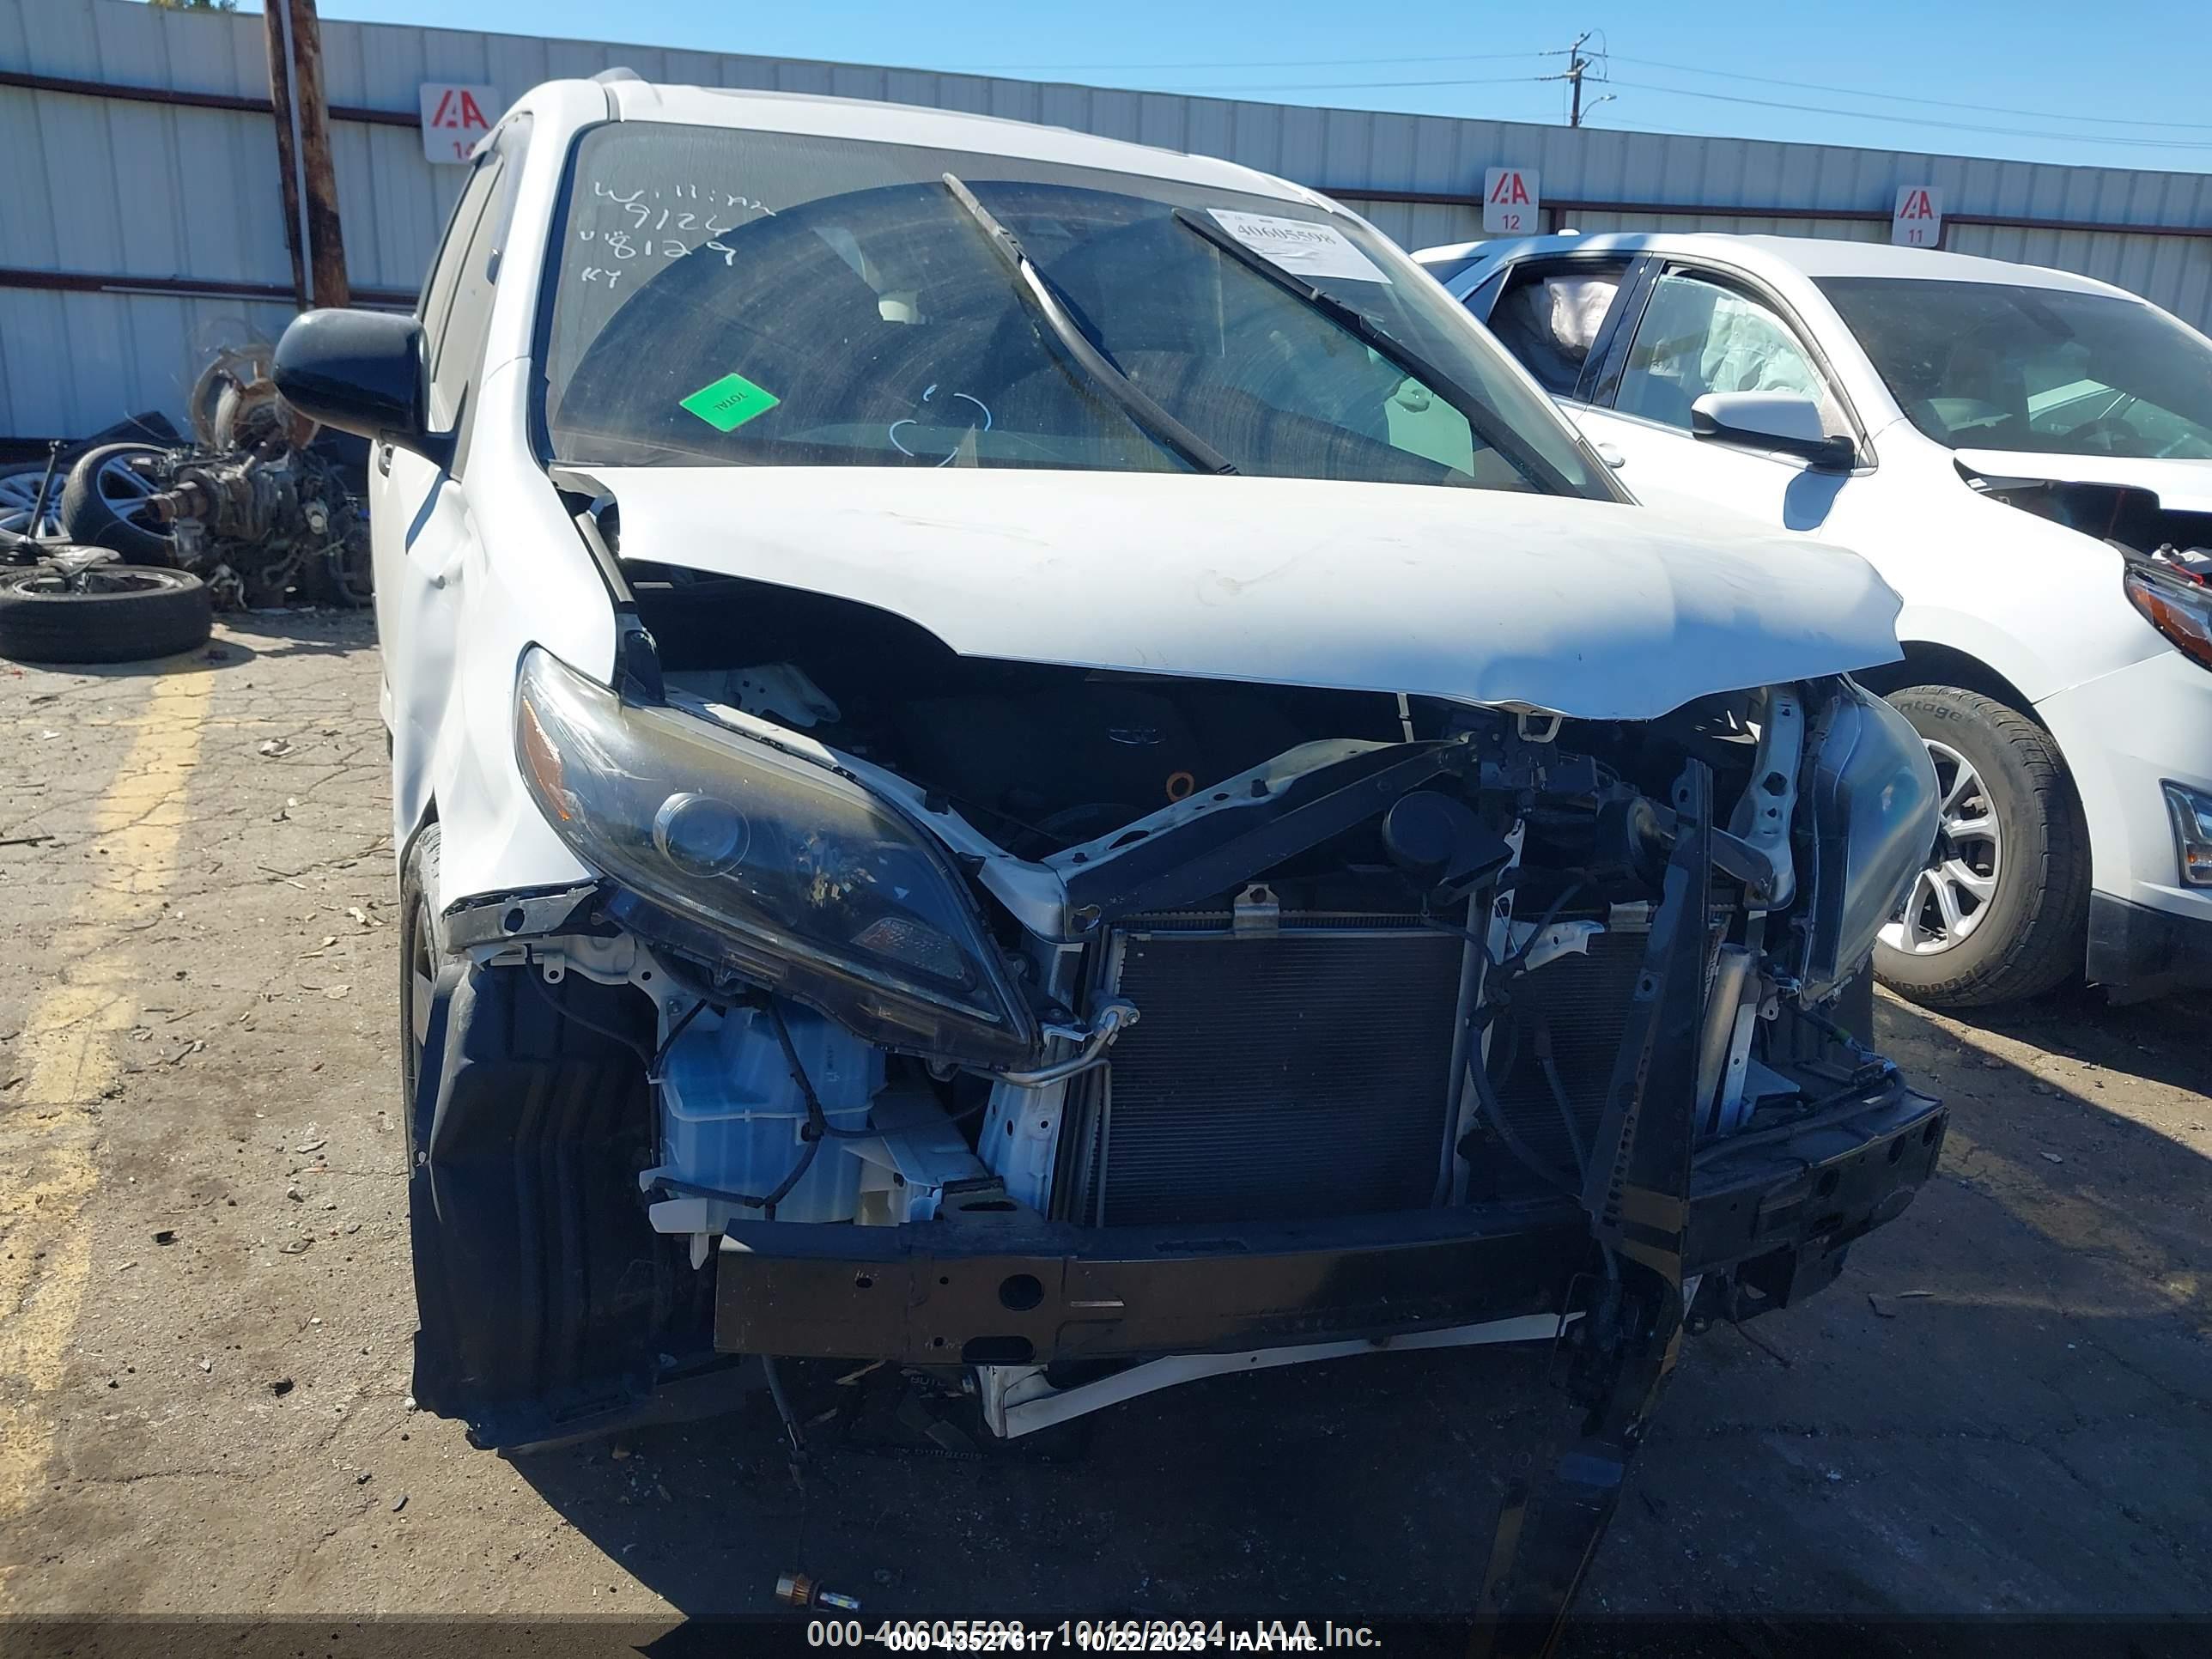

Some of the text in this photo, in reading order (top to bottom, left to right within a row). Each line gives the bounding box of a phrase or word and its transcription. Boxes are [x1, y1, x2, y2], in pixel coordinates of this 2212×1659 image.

[1502, 214, 1520, 231] 12
[1237, 224, 1337, 246] 40605598
[1909, 228, 1923, 244] 11
[714, 392, 749, 411] TOTAL
